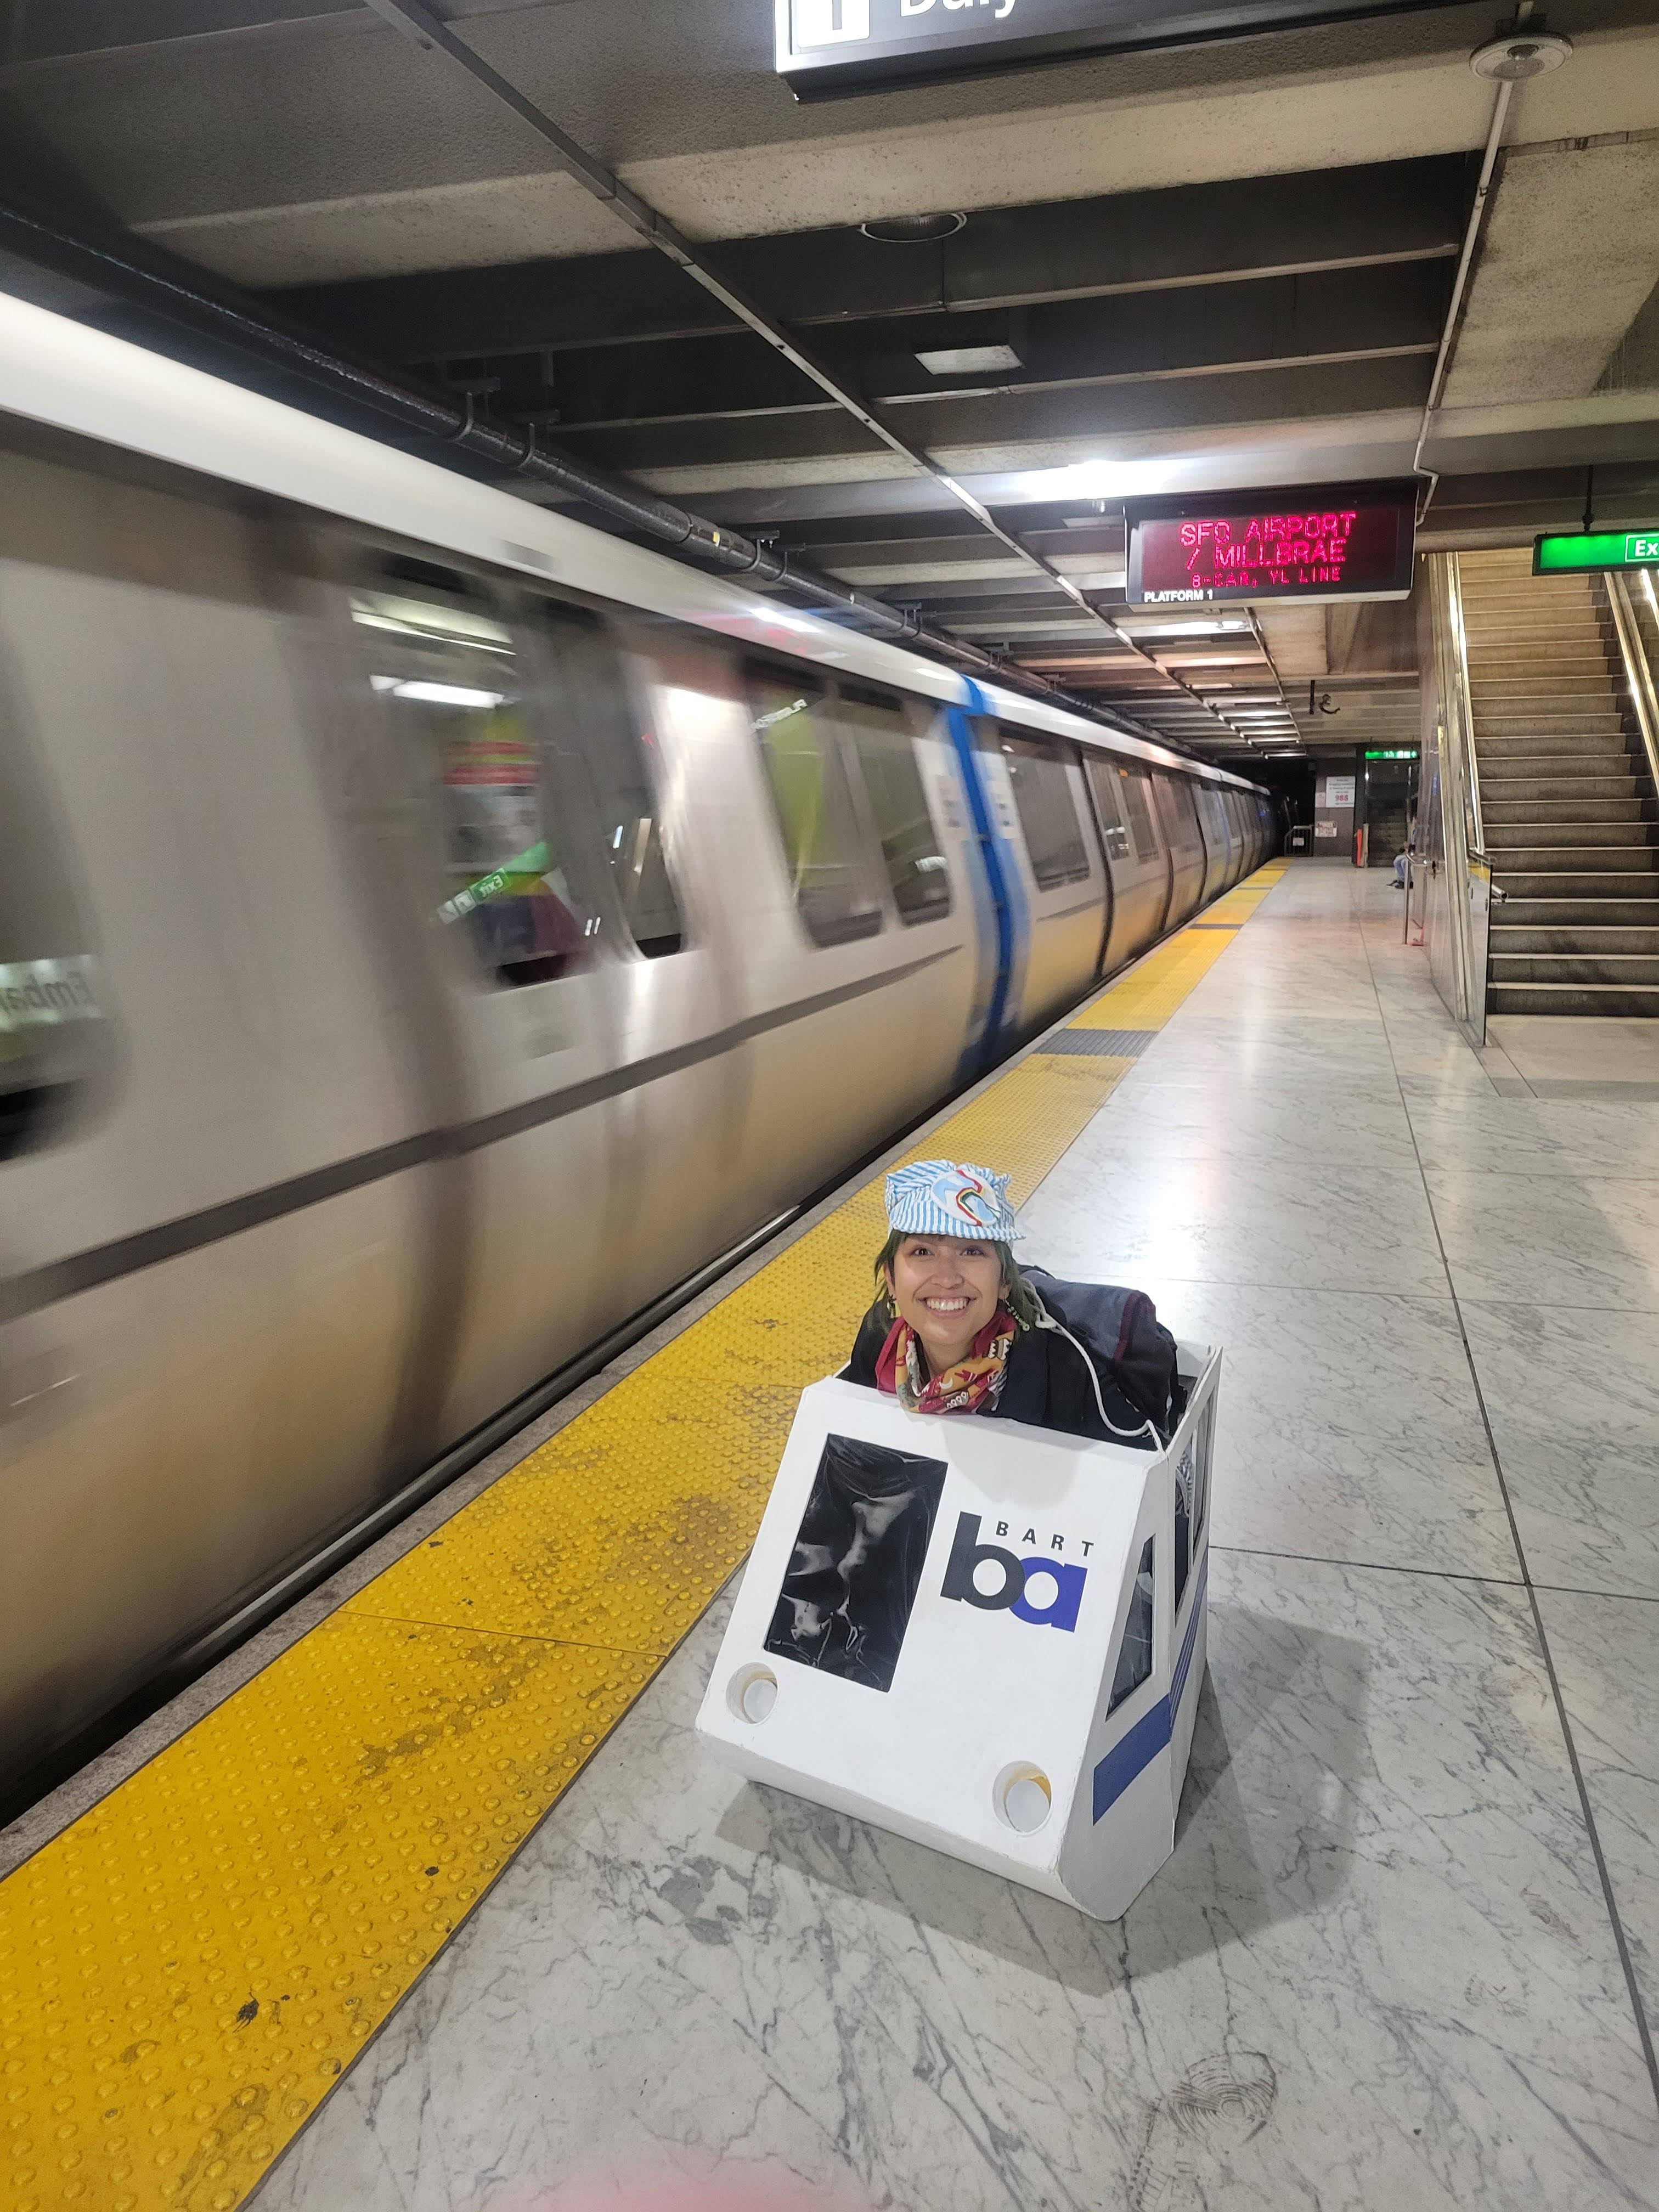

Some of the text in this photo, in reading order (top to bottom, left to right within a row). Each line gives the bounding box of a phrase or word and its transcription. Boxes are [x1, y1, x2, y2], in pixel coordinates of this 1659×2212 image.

[1181, 513, 1356, 546] SFO AIRPORT
[1215, 538, 1346, 568] MILLBRAE
[1269, 568, 1289, 585] YL
[1299, 566, 1341, 583] LINE
[1144, 589, 1214, 603] PLATFORM 1
[995, 1520, 1094, 1557] BART
[940, 1511, 1088, 1633] ba
